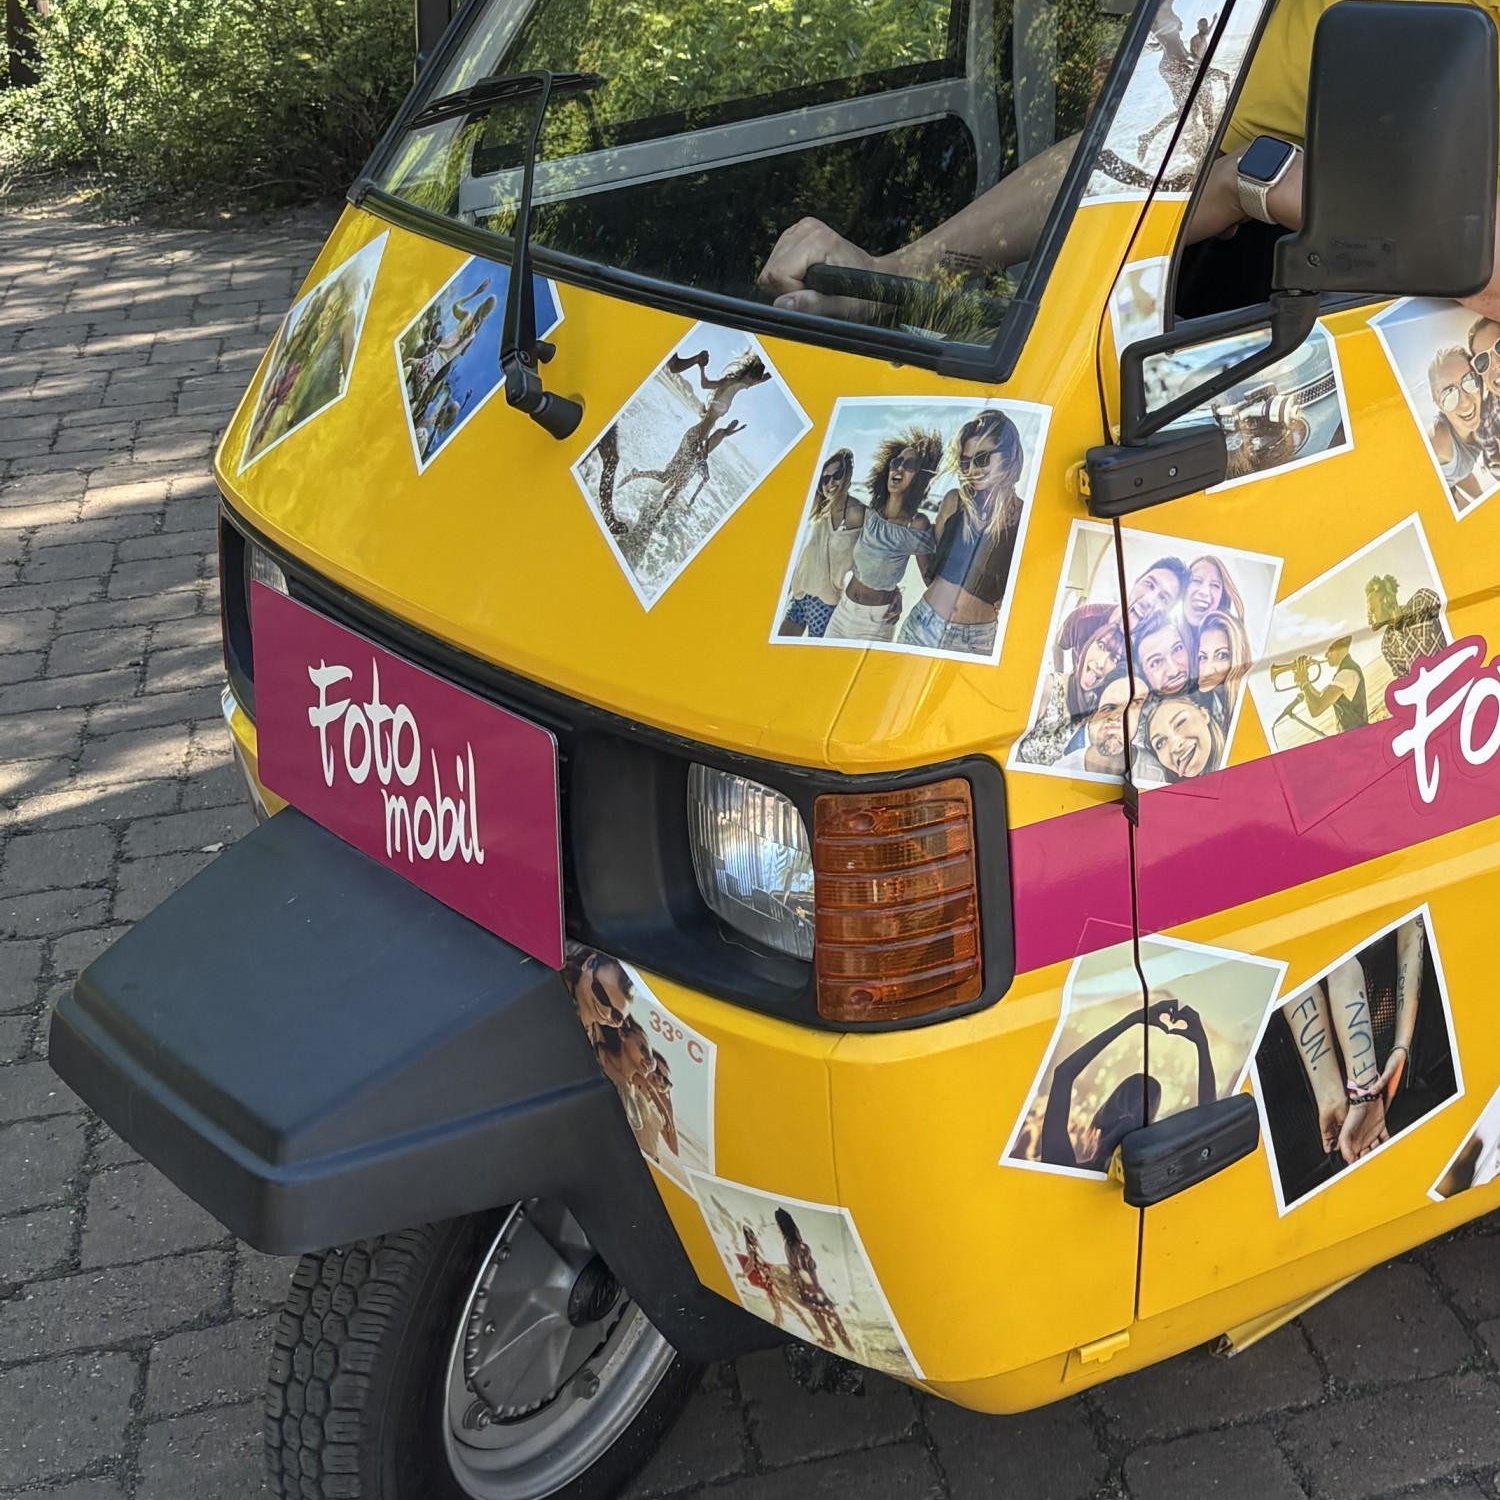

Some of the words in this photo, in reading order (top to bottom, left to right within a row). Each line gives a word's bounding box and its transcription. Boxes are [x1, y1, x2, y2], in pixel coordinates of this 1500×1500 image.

[307, 656, 421, 788] Foto
[381, 741, 485, 865] mobil
[687, 1039, 704, 1064] C
[1291, 995, 1332, 1071] FUN.
